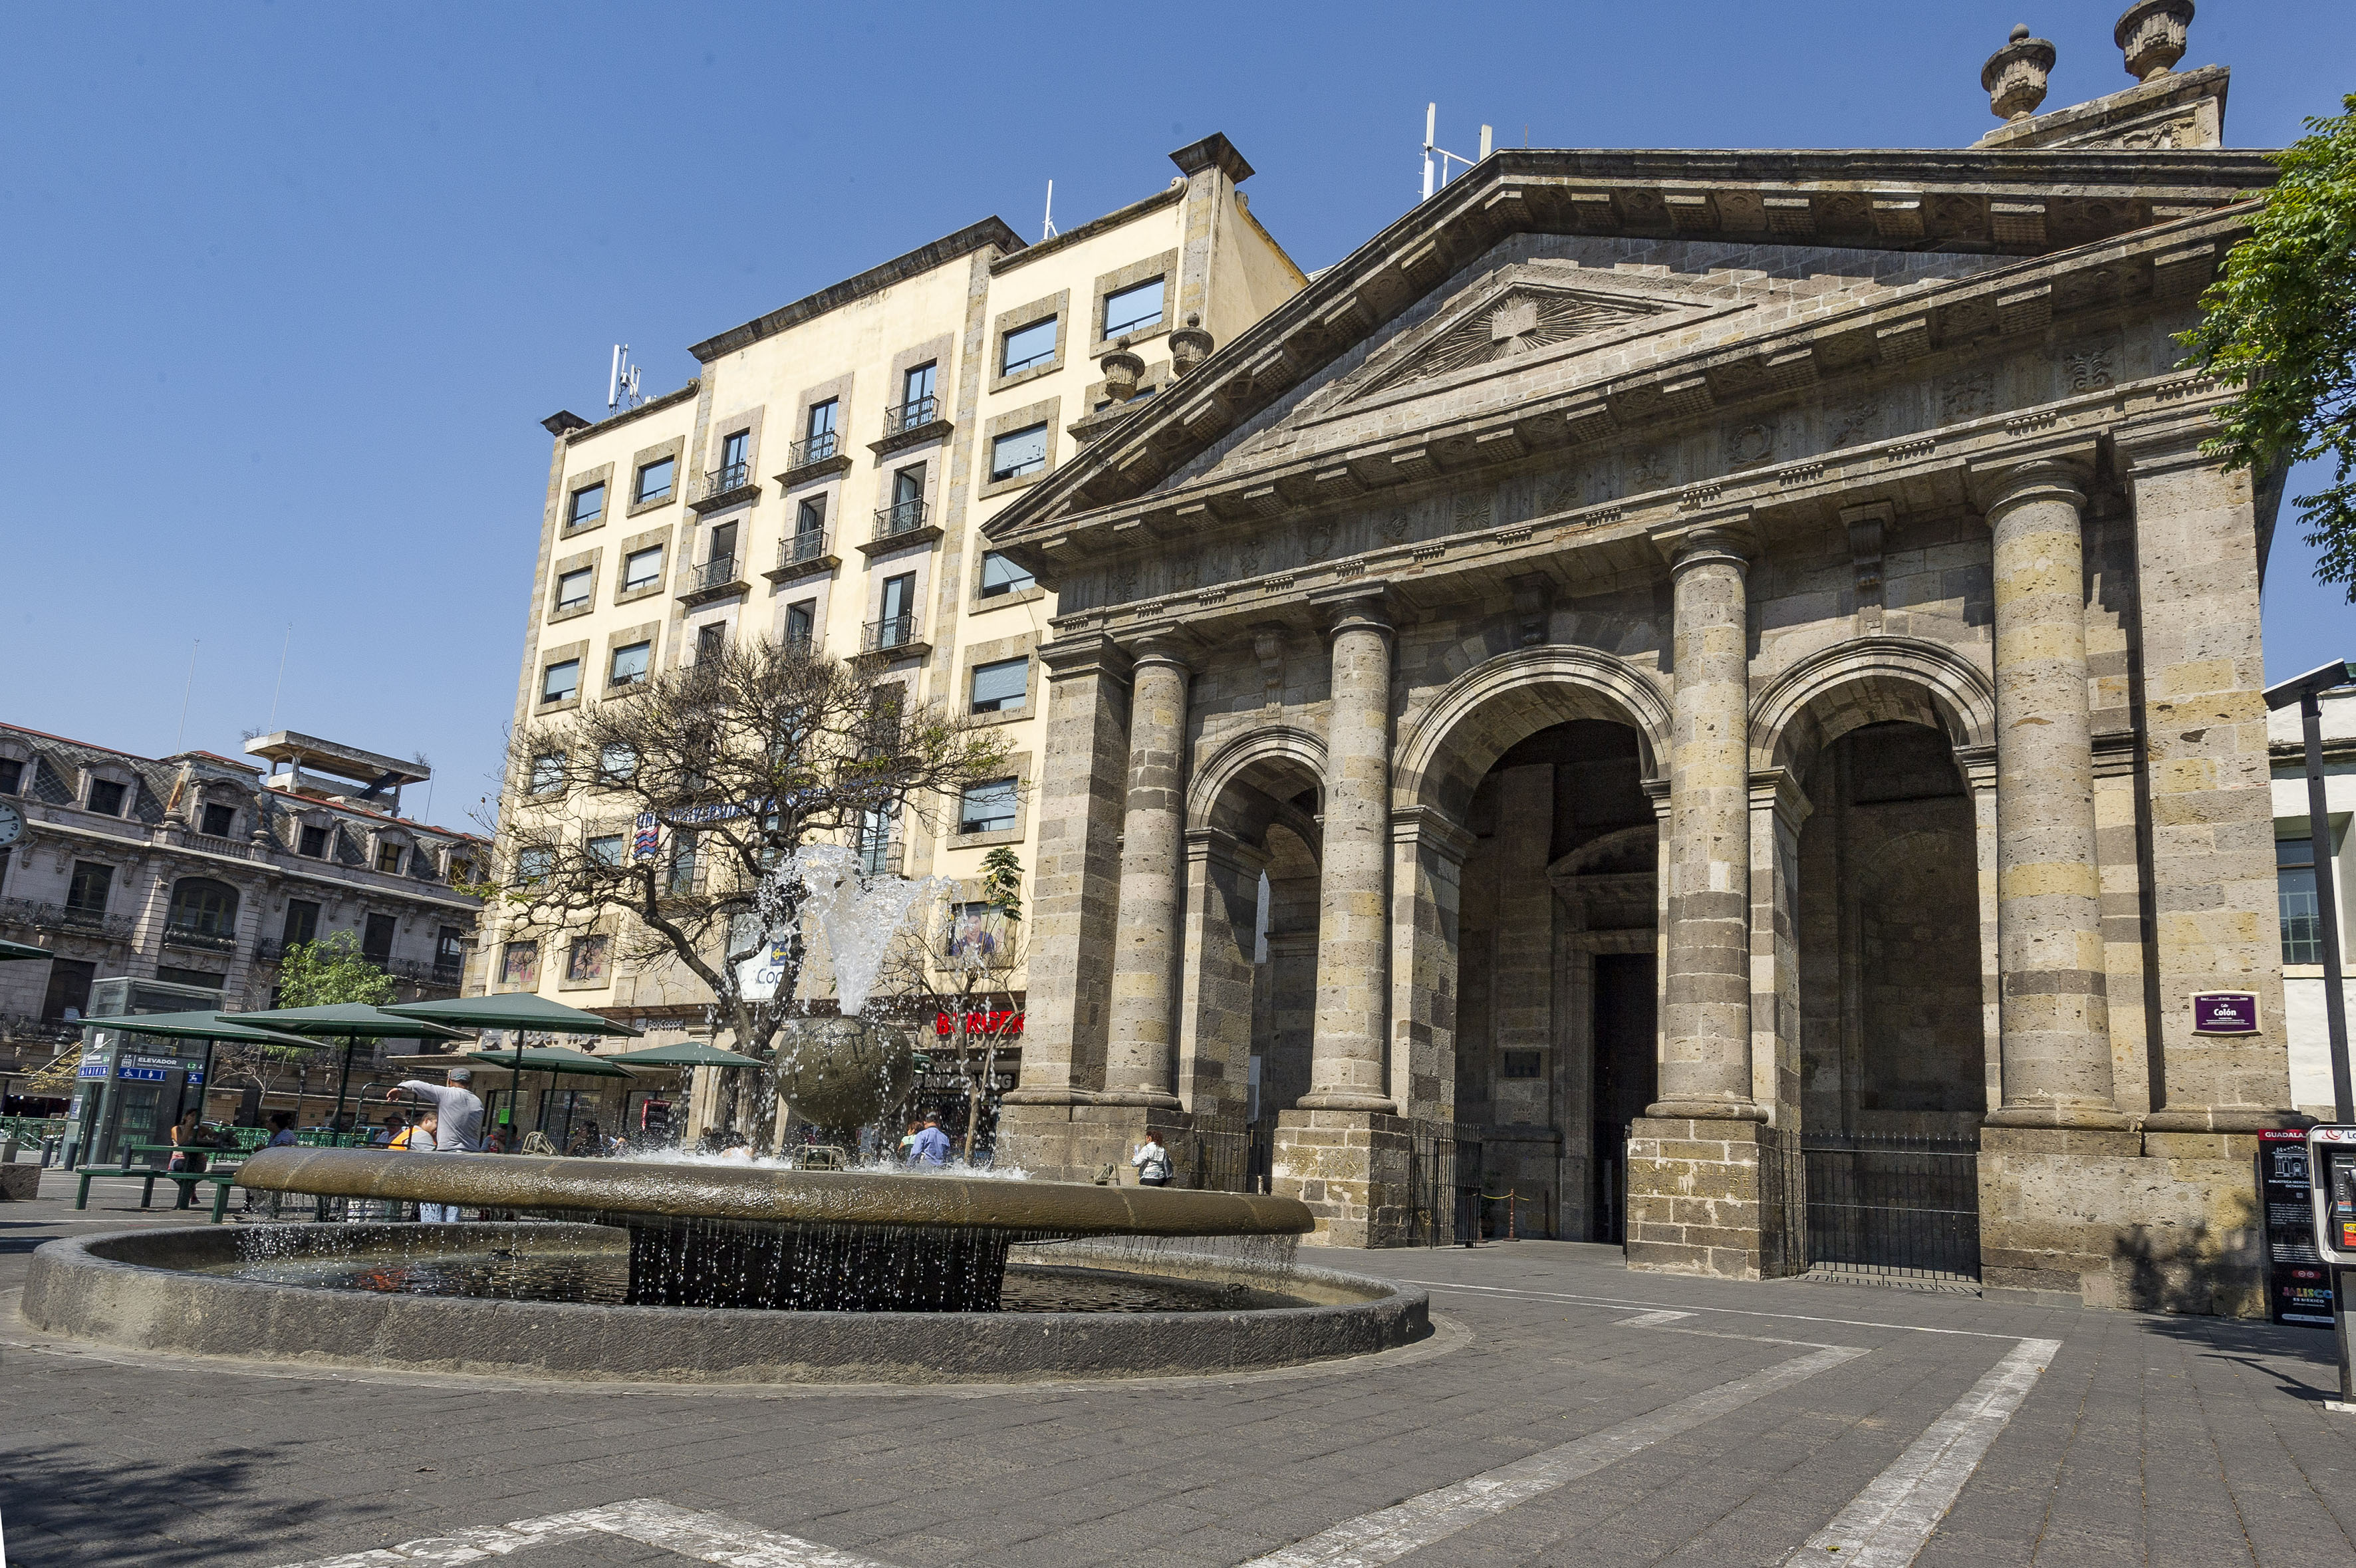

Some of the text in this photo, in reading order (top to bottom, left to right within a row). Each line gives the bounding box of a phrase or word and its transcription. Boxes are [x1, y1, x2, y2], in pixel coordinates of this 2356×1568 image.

[757, 968, 783, 989] Cop
[648, 1019, 685, 1031] BanCoppel
[138, 1057, 178, 1065] ELEVADOR
[924, 1074, 976, 1089] BURG
[1729, 1178, 1752, 1188] DE
[2282, 1286, 2333, 1299] JALISCO
